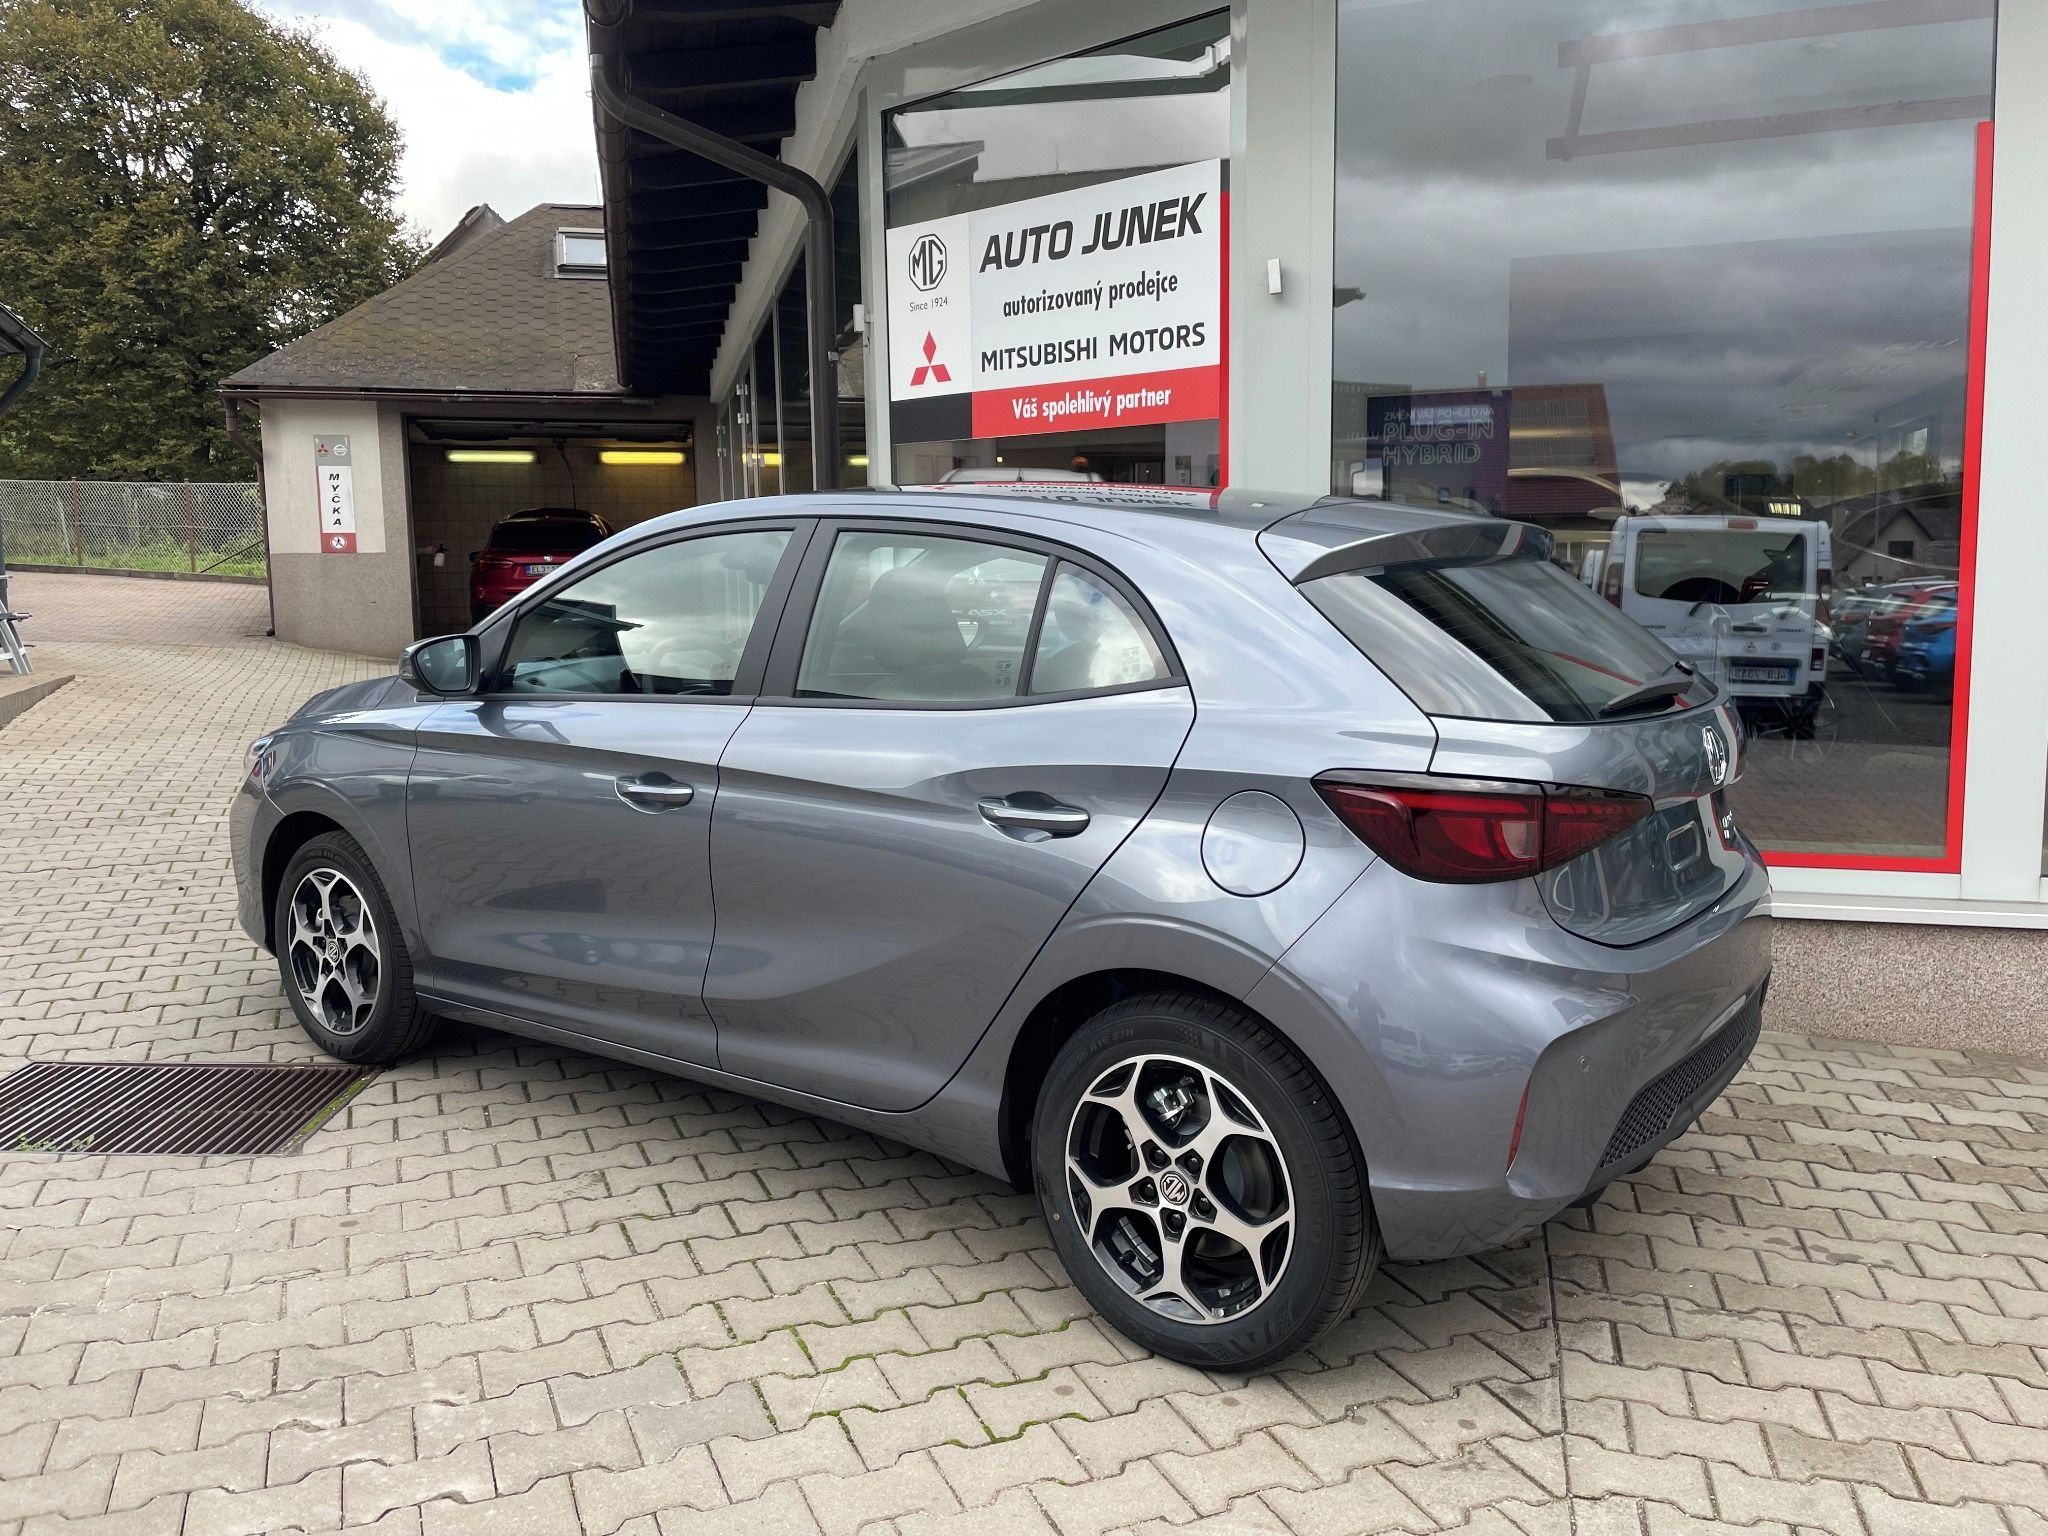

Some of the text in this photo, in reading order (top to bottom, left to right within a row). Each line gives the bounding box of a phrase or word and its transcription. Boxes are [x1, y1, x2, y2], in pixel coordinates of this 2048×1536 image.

[979, 192, 1207, 273] AUTO JUNEK
[911, 237, 945, 288] MG
[909, 296, 948, 312] Since 1924
[1003, 270, 1178, 318] autorizovaný prodejce
[981, 322, 1205, 372] MITSUBISHI MOTORS
[1012, 387, 1172, 422] Váš spolehlivý partner
[1384, 420, 1493, 443] PLUG-IN
[1383, 443, 1480, 465] HYBRID
